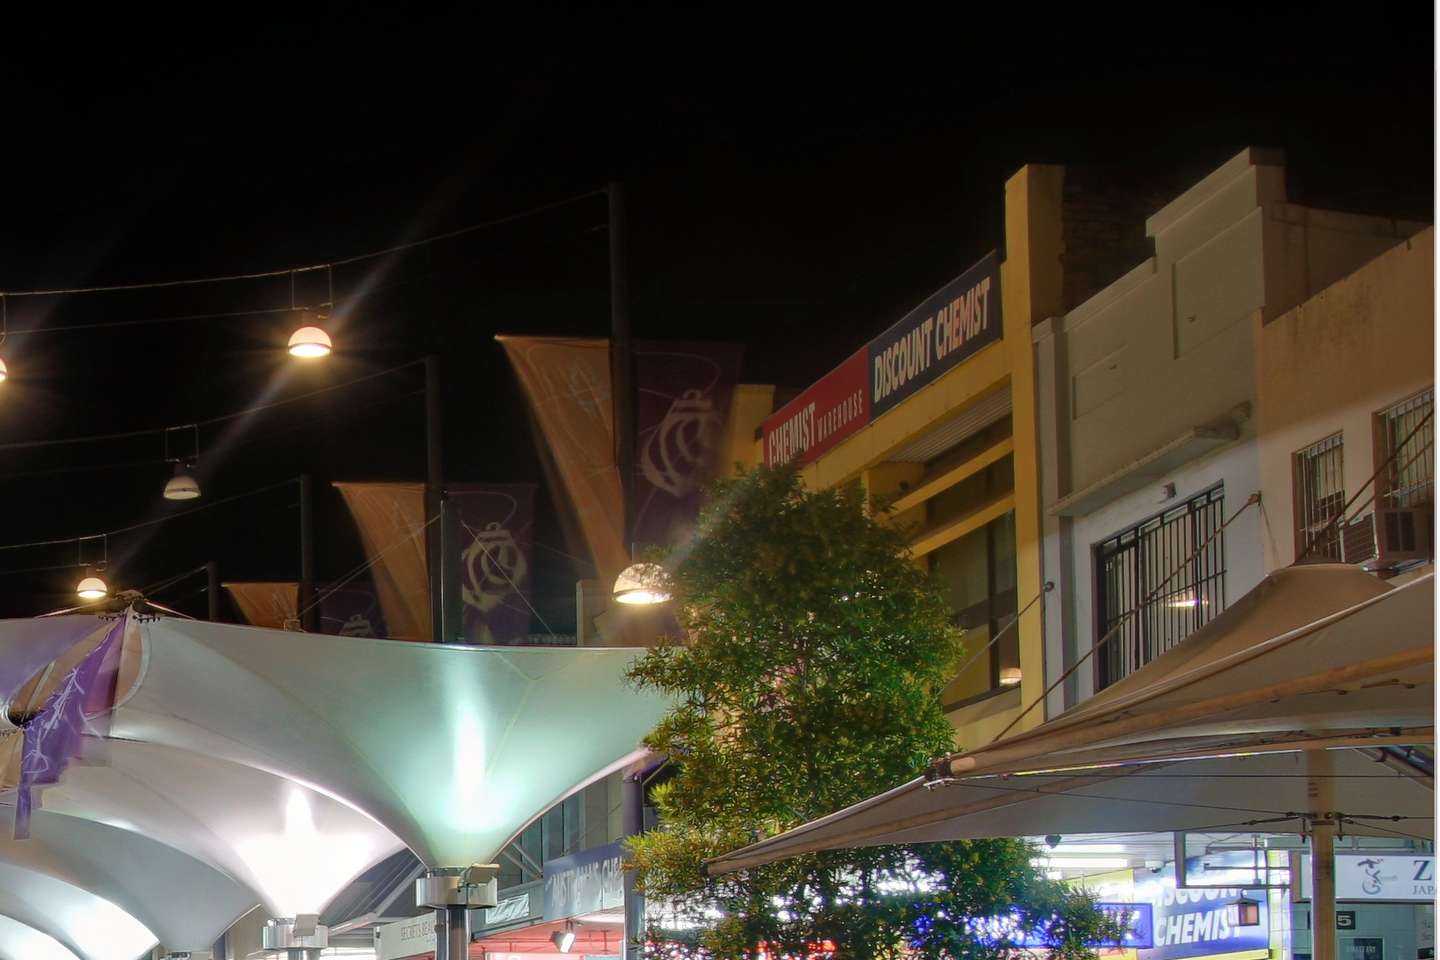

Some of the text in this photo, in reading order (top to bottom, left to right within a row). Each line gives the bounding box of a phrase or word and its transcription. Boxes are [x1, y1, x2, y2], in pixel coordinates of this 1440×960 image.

[874, 276, 991, 404] DISCOUNT CHEMIST
[768, 389, 863, 472] CHEMIST WAREHOUSE
[1412, 884, 1434, 896] JAP
